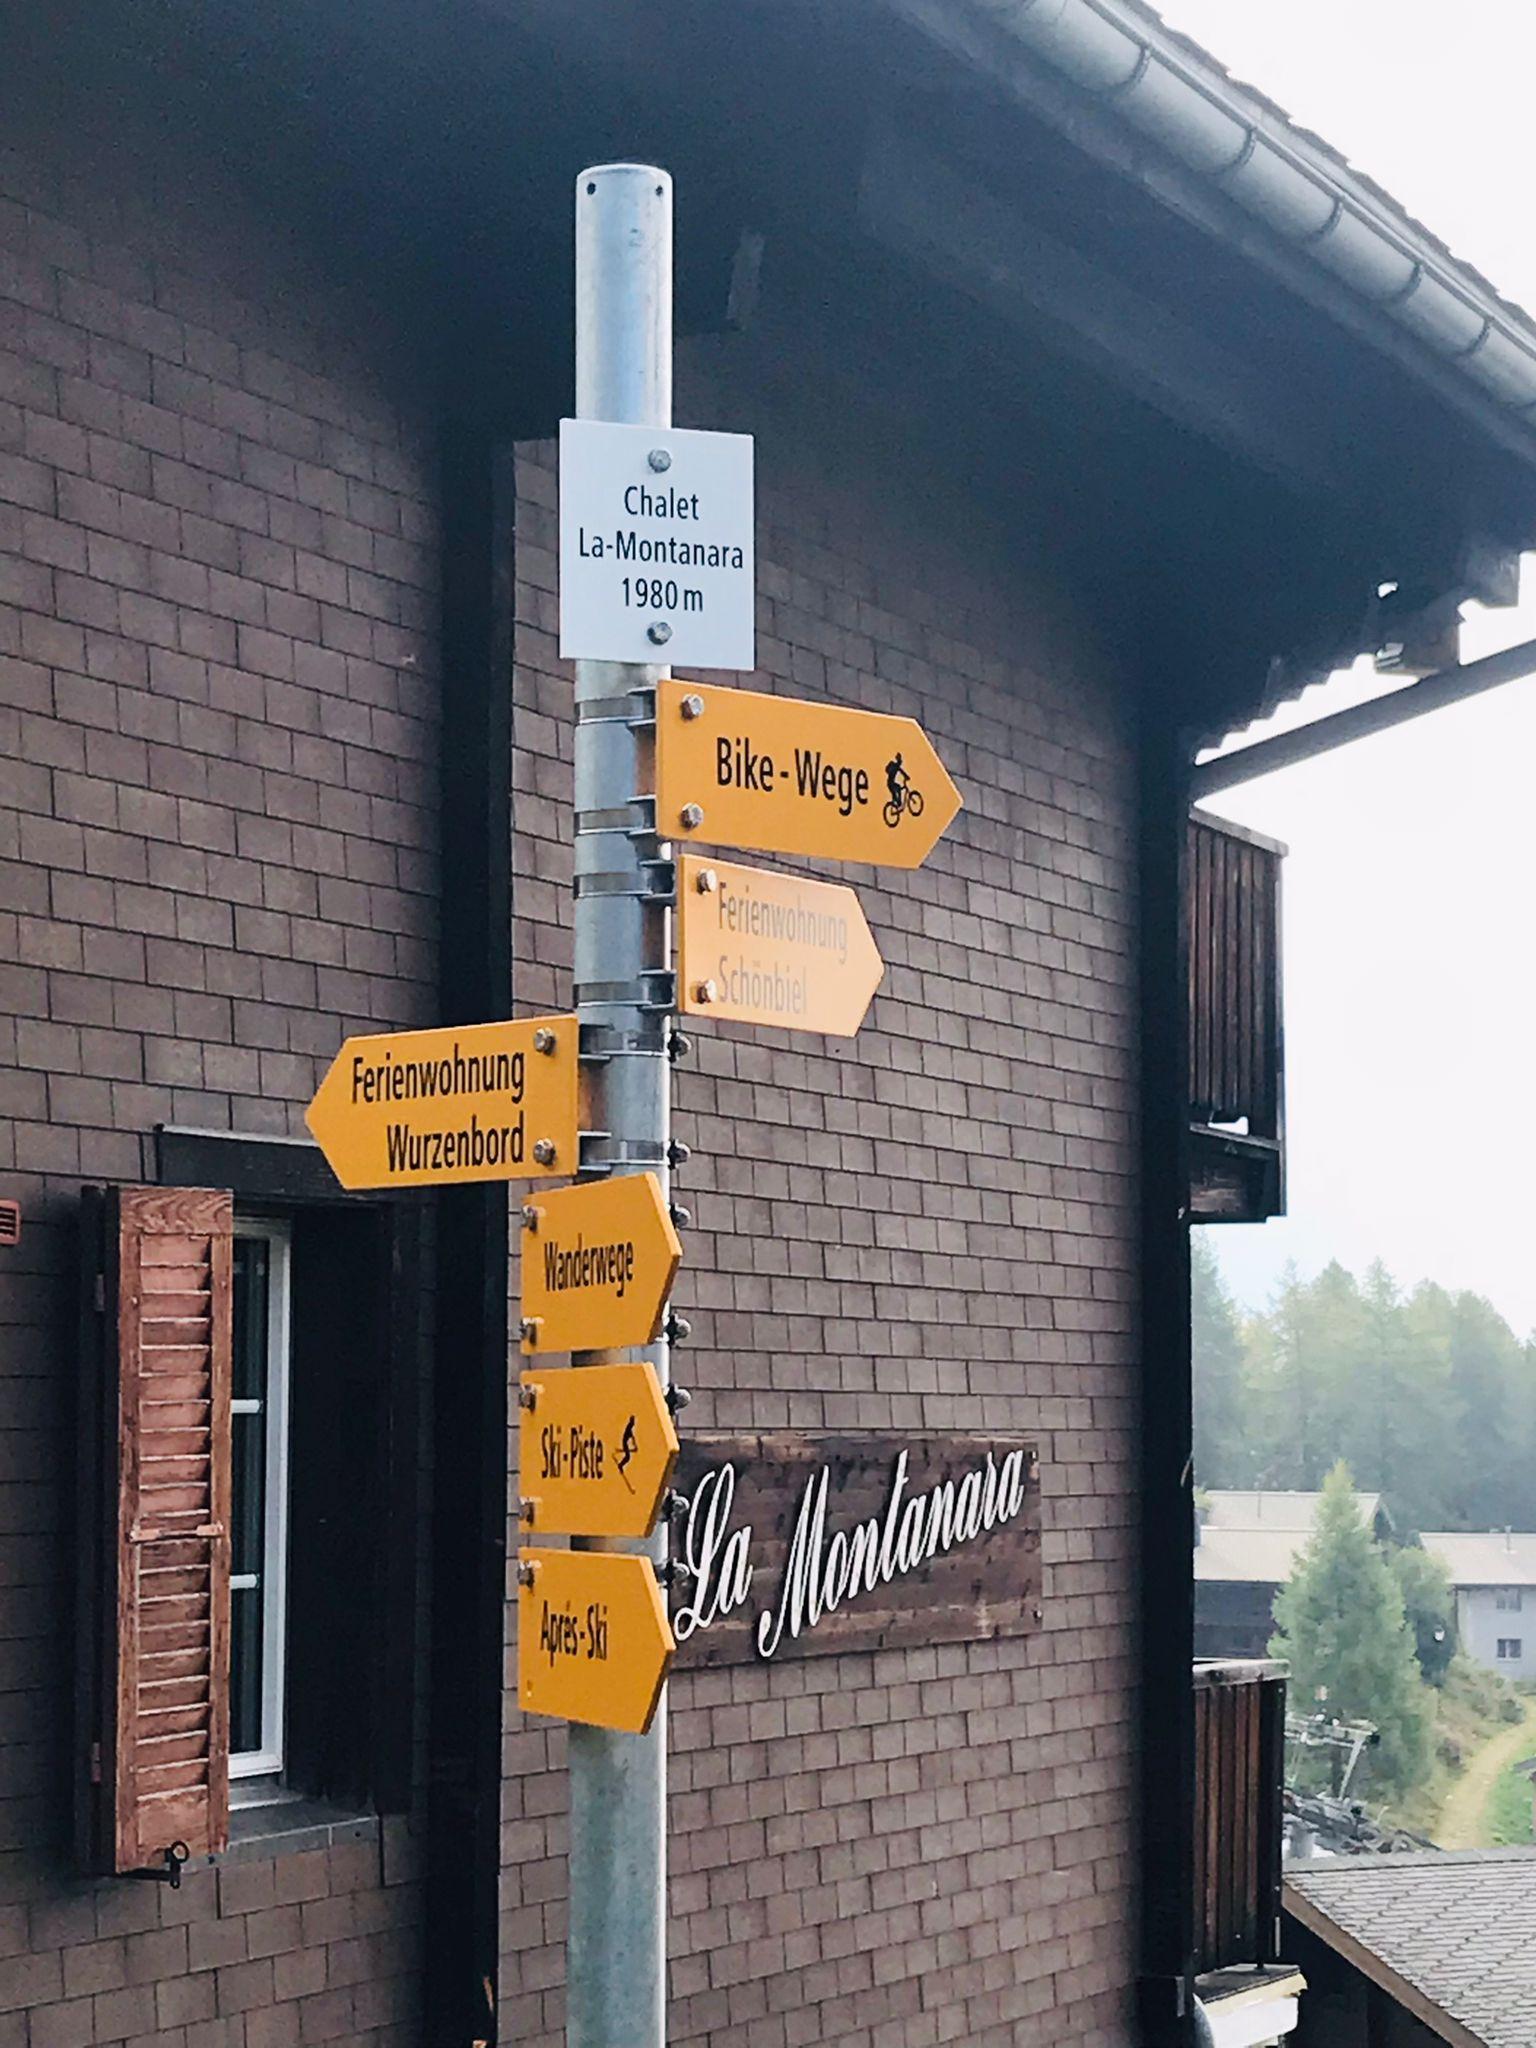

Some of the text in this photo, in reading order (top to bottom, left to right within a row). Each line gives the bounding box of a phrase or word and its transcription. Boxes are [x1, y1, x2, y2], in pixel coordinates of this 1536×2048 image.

[623, 484, 700, 521] Chalet
[578, 526, 745, 570] La-Montanara
[715, 736, 870, 817] Bike-Wege
[718, 881, 849, 966] Ferienwohnung
[718, 955, 808, 1016] Schönbiel
[351, 1043, 526, 1105] Ferienwohnung
[386, 1110, 526, 1172] Wurzenbord
[543, 1233, 634, 1298] Wanderwege
[540, 1424, 604, 1481] Ski-Piste
[674, 1449, 1026, 1658] La Montanara
